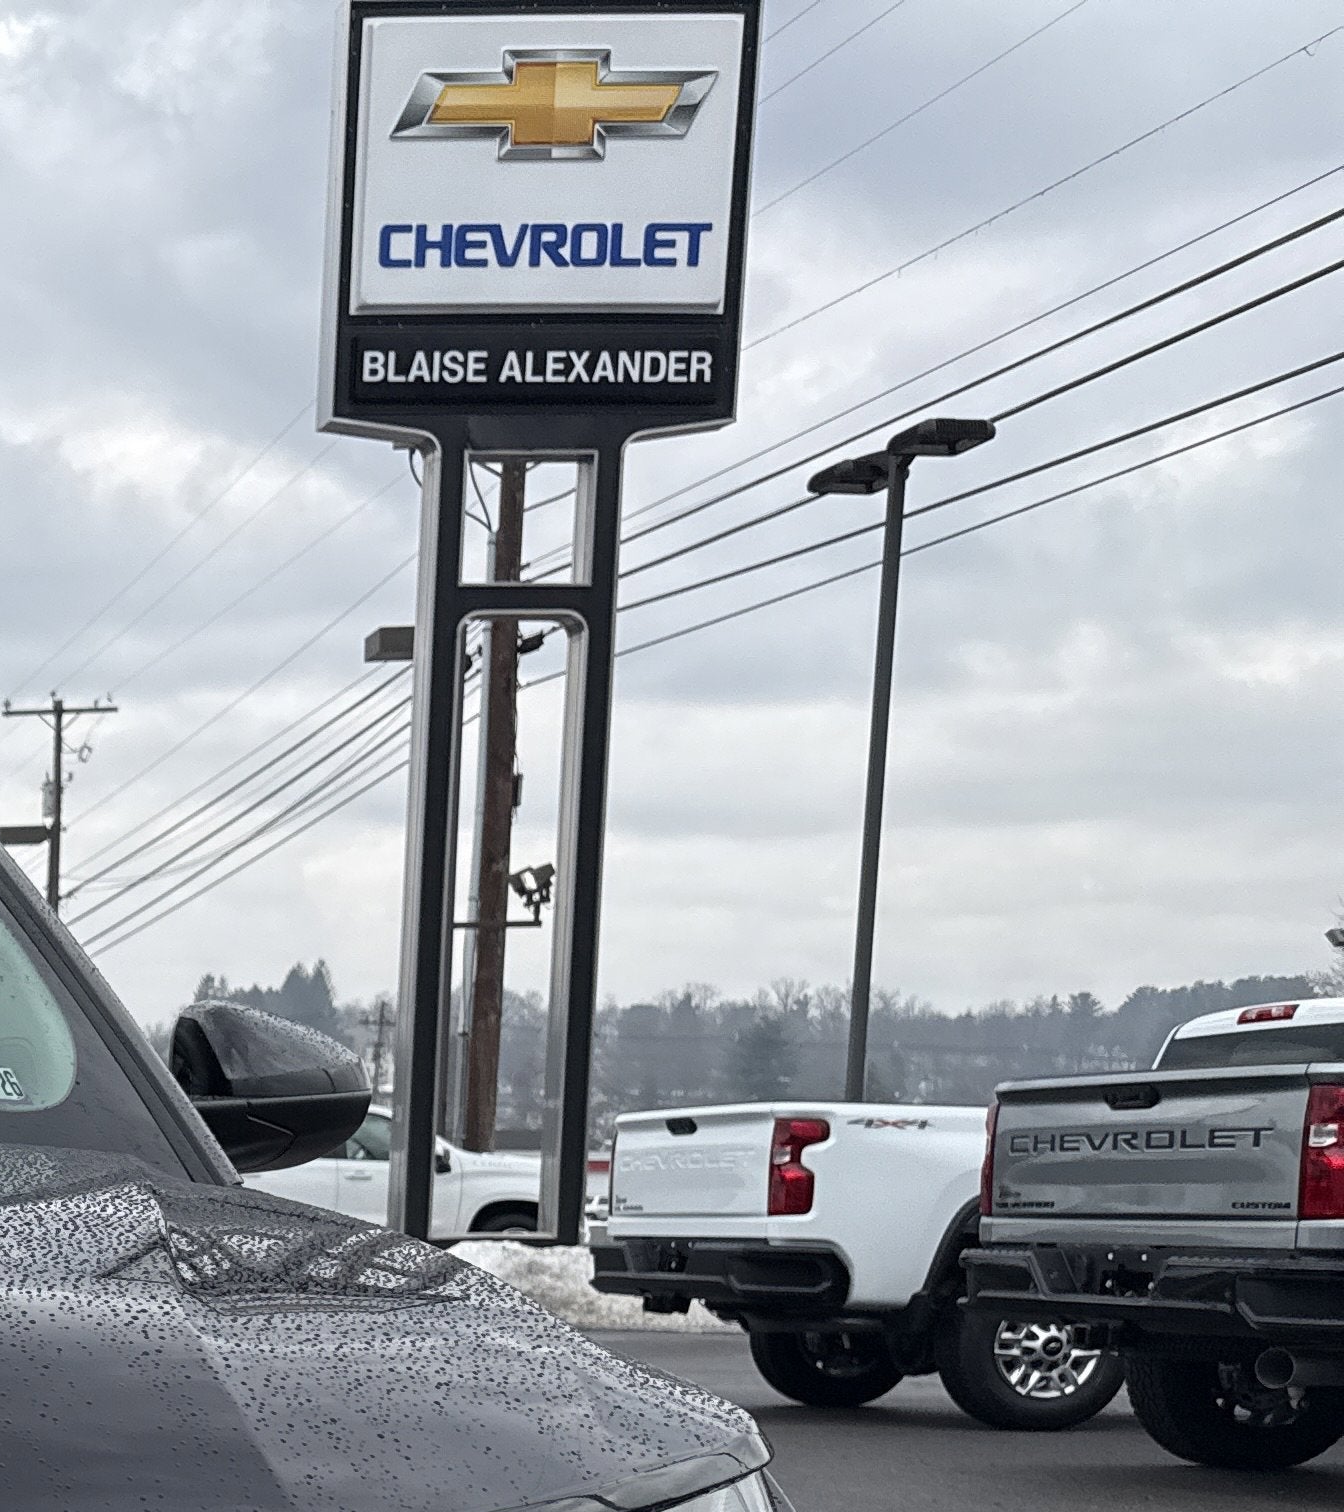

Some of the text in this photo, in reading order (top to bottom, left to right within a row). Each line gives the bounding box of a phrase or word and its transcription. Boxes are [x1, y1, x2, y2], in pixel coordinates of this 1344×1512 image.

[378, 223, 712, 268] CHEVROLET
[362, 350, 712, 384] BLAISE ALEXANDER
[1010, 1127, 1274, 1155] CHEVROLET
